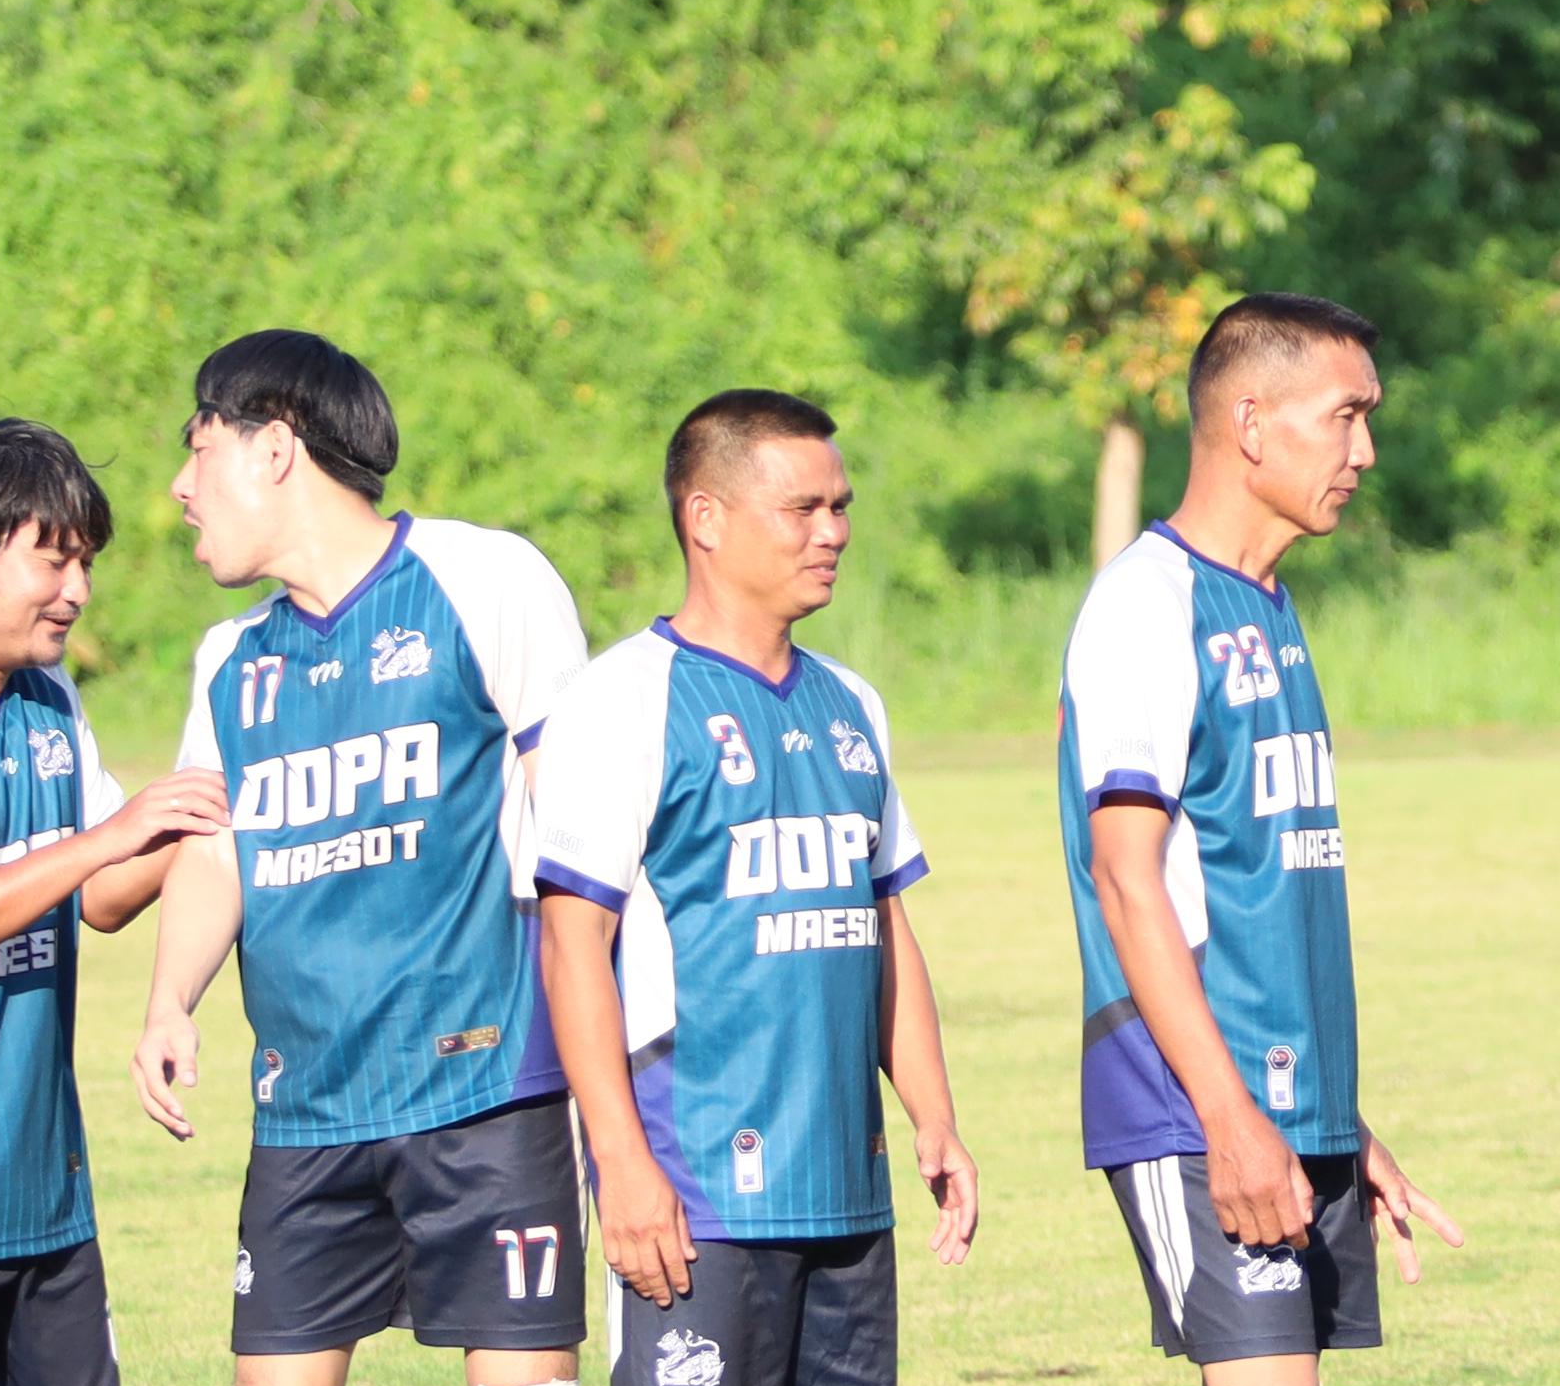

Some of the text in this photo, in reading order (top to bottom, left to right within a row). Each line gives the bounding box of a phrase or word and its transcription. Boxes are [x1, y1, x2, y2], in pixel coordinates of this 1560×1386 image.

[241, 654, 287, 731] 17
[1207, 624, 1281, 707] 23
[231, 720, 441, 832] DOPA
[706, 713, 757, 786] 3
[253, 819, 427, 888] MAESOT
[1279, 828, 1345, 871] MAES
[756, 907, 882, 956] MAESO
[493, 1225, 560, 1300] 17
